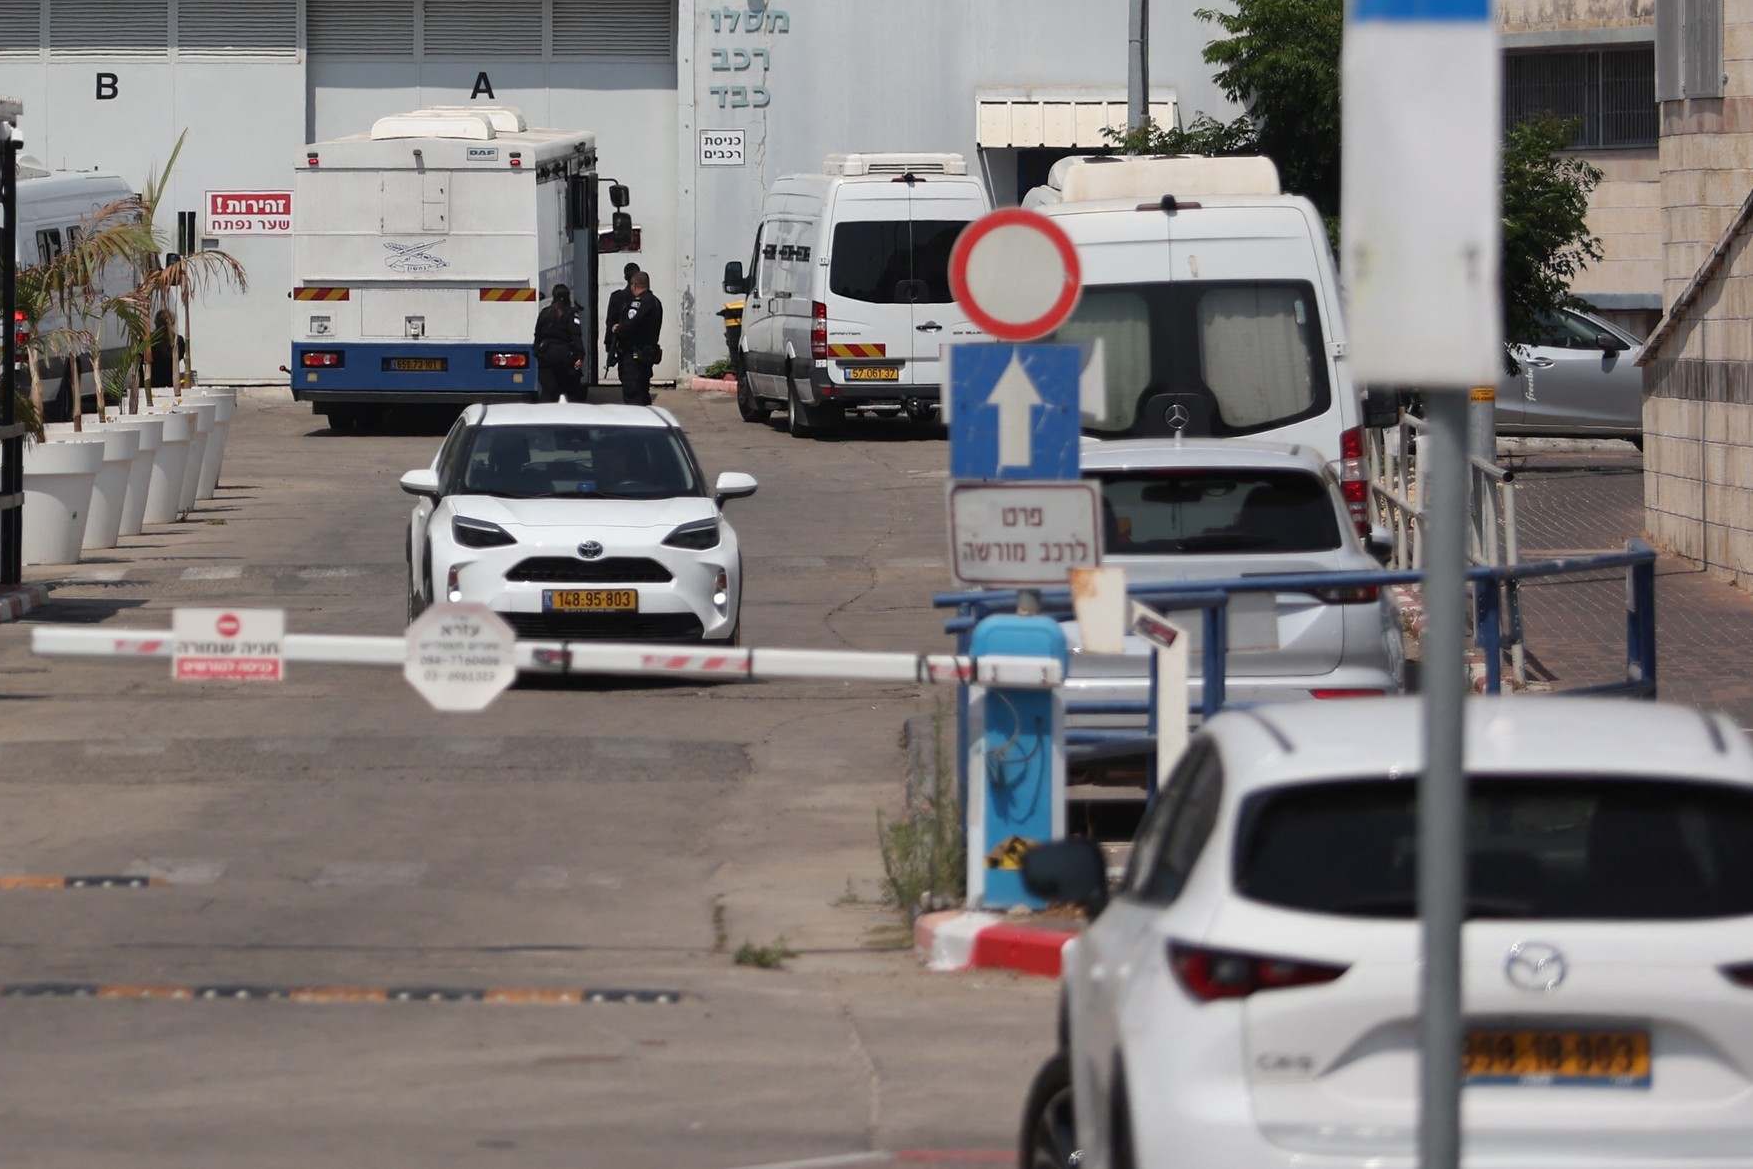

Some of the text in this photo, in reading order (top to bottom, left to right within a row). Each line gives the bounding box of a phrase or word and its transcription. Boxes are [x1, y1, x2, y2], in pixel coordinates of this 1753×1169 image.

[709, 47, 771, 73] רכב
[95, 72, 119, 100] B
[469, 71, 496, 100] A
[708, 85, 772, 109] כבד
[703, 135, 742, 147] כניסת
[703, 148, 742, 160] רכבים
[211, 219, 290, 230] שער נפתח
[1524, 367, 1537, 402] freesbe
[1001, 506, 1043, 527] פרט
[962, 539, 1088, 562] לרכב מורשה
[440, 623, 481, 637] עזרא
[176, 641, 279, 654] חניה שמורה
